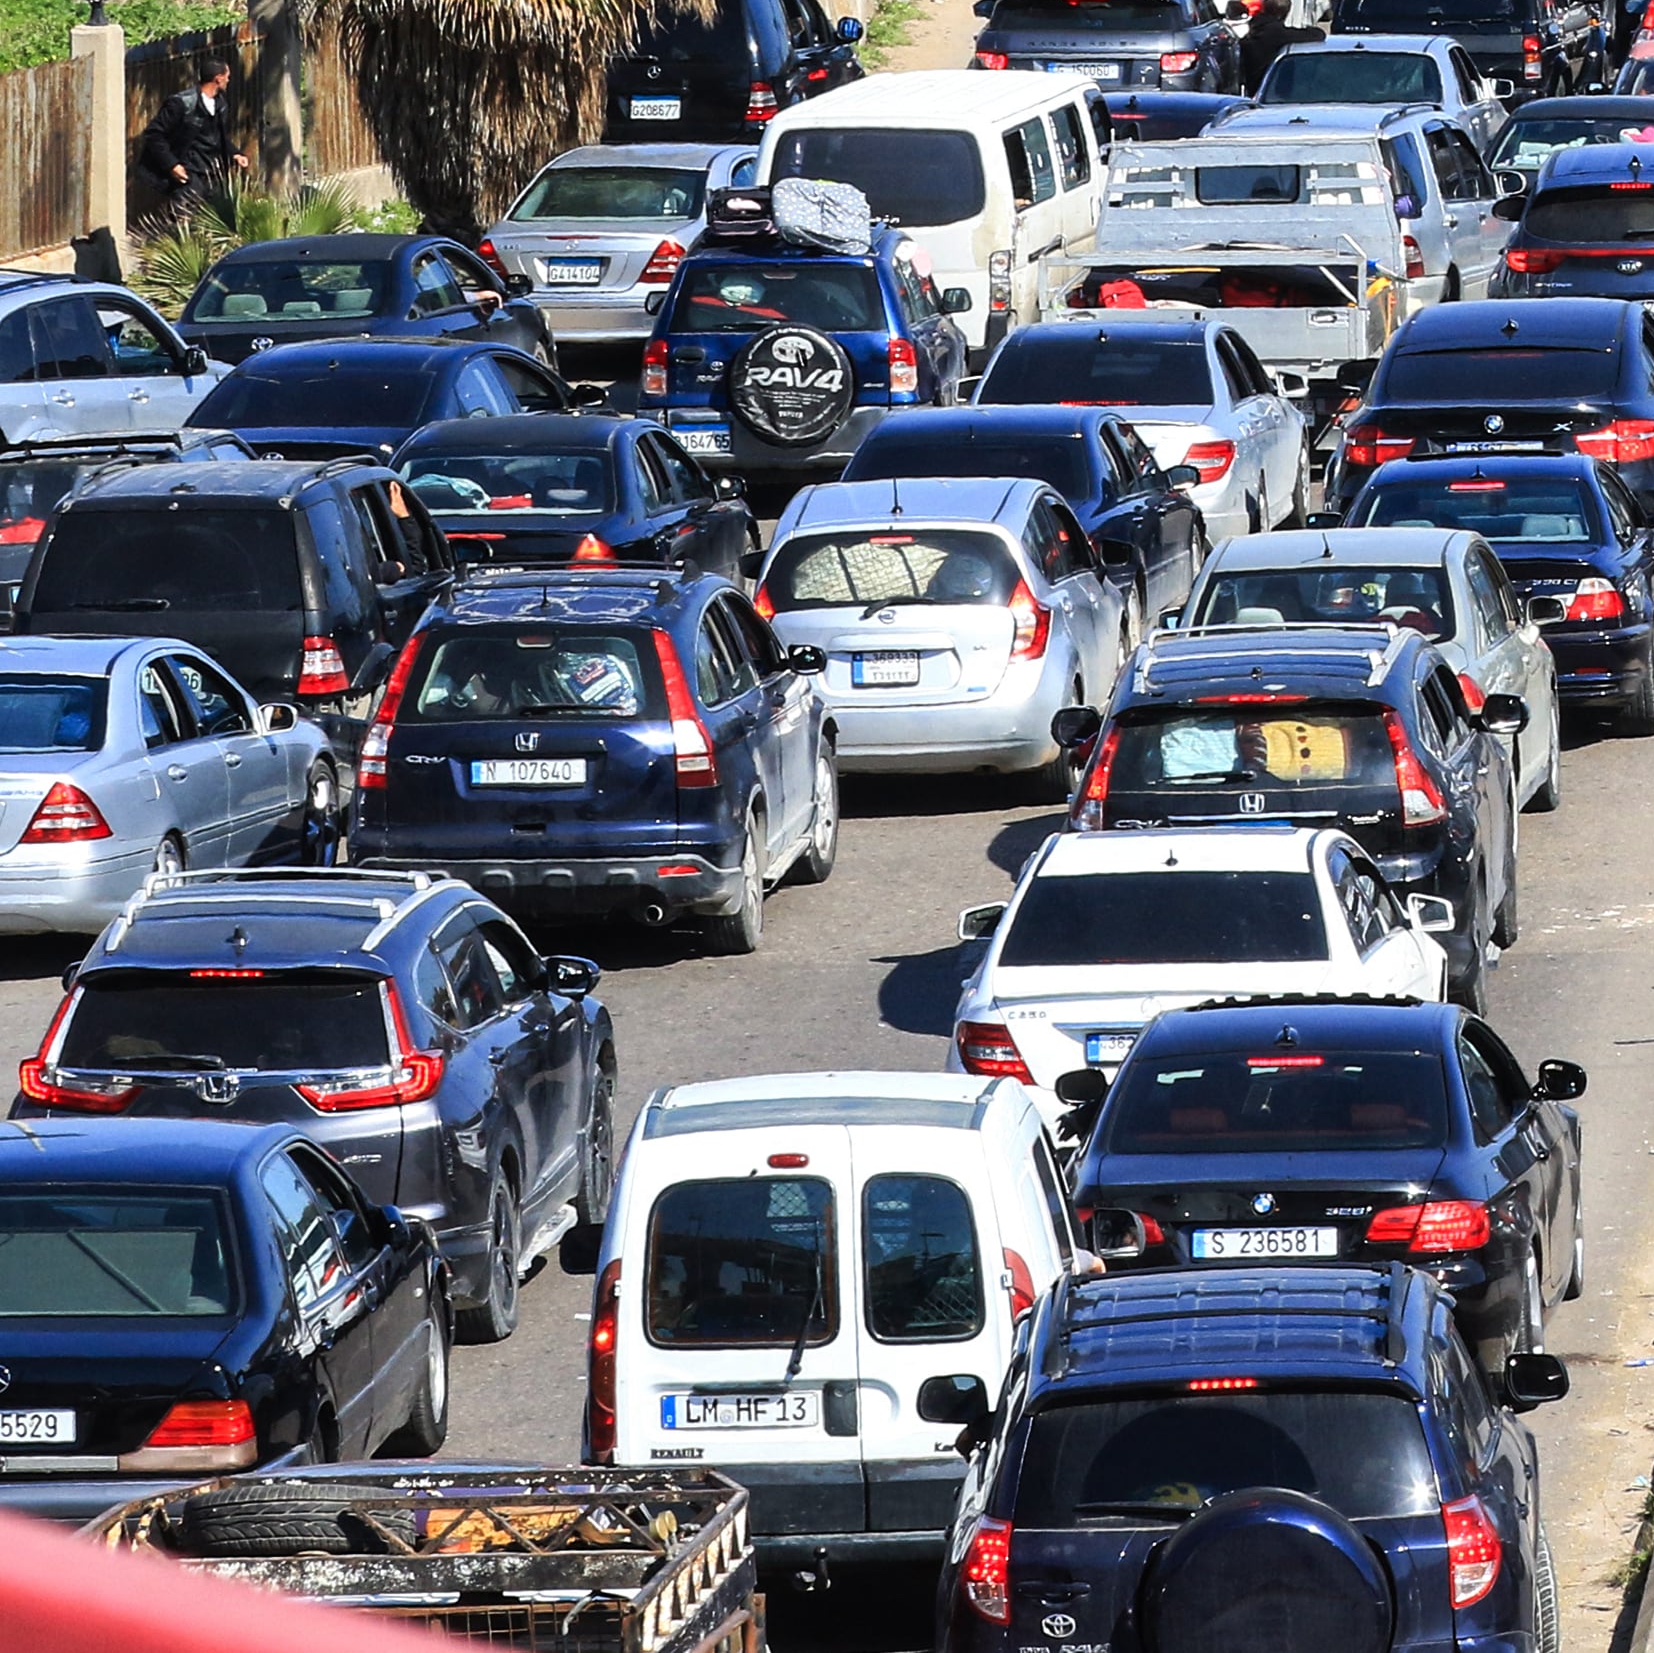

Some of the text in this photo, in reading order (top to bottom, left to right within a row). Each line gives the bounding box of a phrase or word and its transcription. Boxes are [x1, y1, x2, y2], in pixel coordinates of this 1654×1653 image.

[631, 101, 680, 117] G208677
[551, 268, 601, 282] G414104
[744, 367, 844, 393] RAV4
[486, 762, 574, 781] N 107640
[1212, 1231, 1321, 1255] S 236581
[686, 1397, 808, 1425] LM HF 13
[1, 1413, 58, 1438] 5529
[651, 1448, 705, 1460] RENAULT
